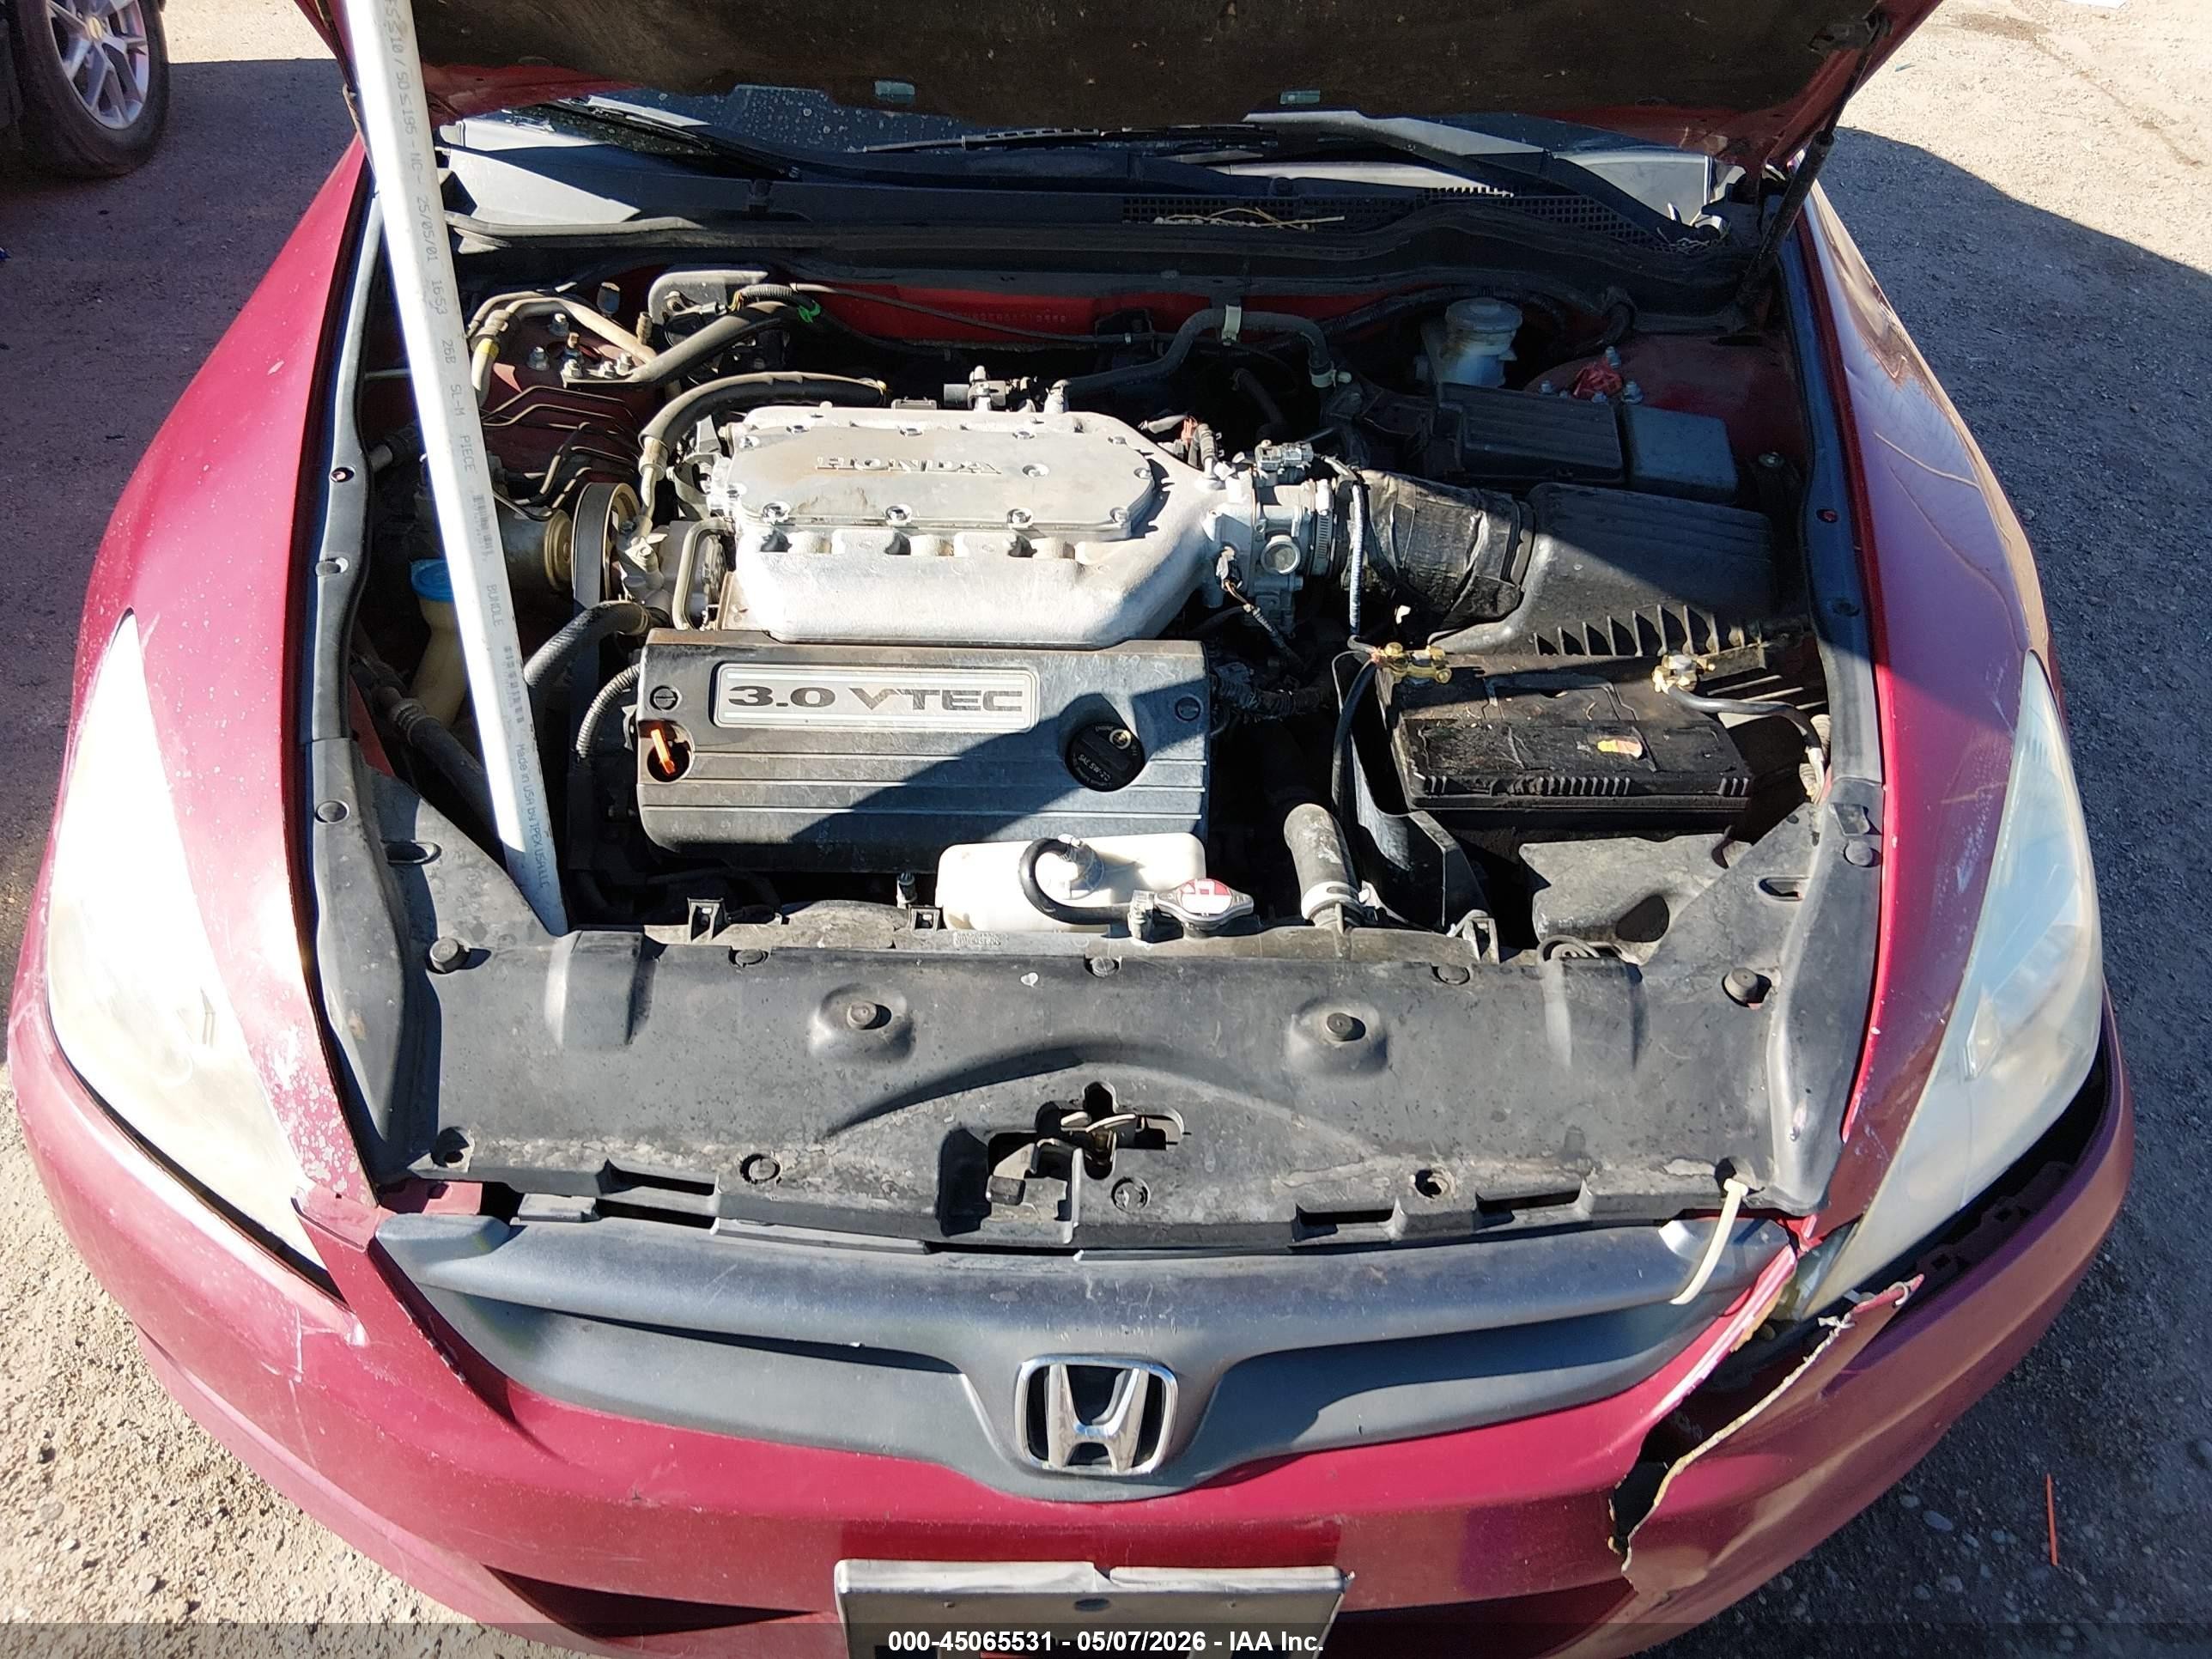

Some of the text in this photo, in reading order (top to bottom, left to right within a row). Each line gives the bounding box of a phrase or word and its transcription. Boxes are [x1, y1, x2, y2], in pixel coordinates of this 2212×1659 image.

[415, 195, 440, 261] 25/05/01
[459, 434, 477, 471] PIECE
[816, 456, 1003, 475] HONDA
[485, 583, 504, 627] BUNDLE
[727, 685, 1023, 712] 3.0 VTEC
[514, 743, 529, 771] Made
[520, 773, 530, 783] in
[522, 784, 536, 805] USA
[526, 806, 538, 821] by
[533, 848, 547, 869] USA
